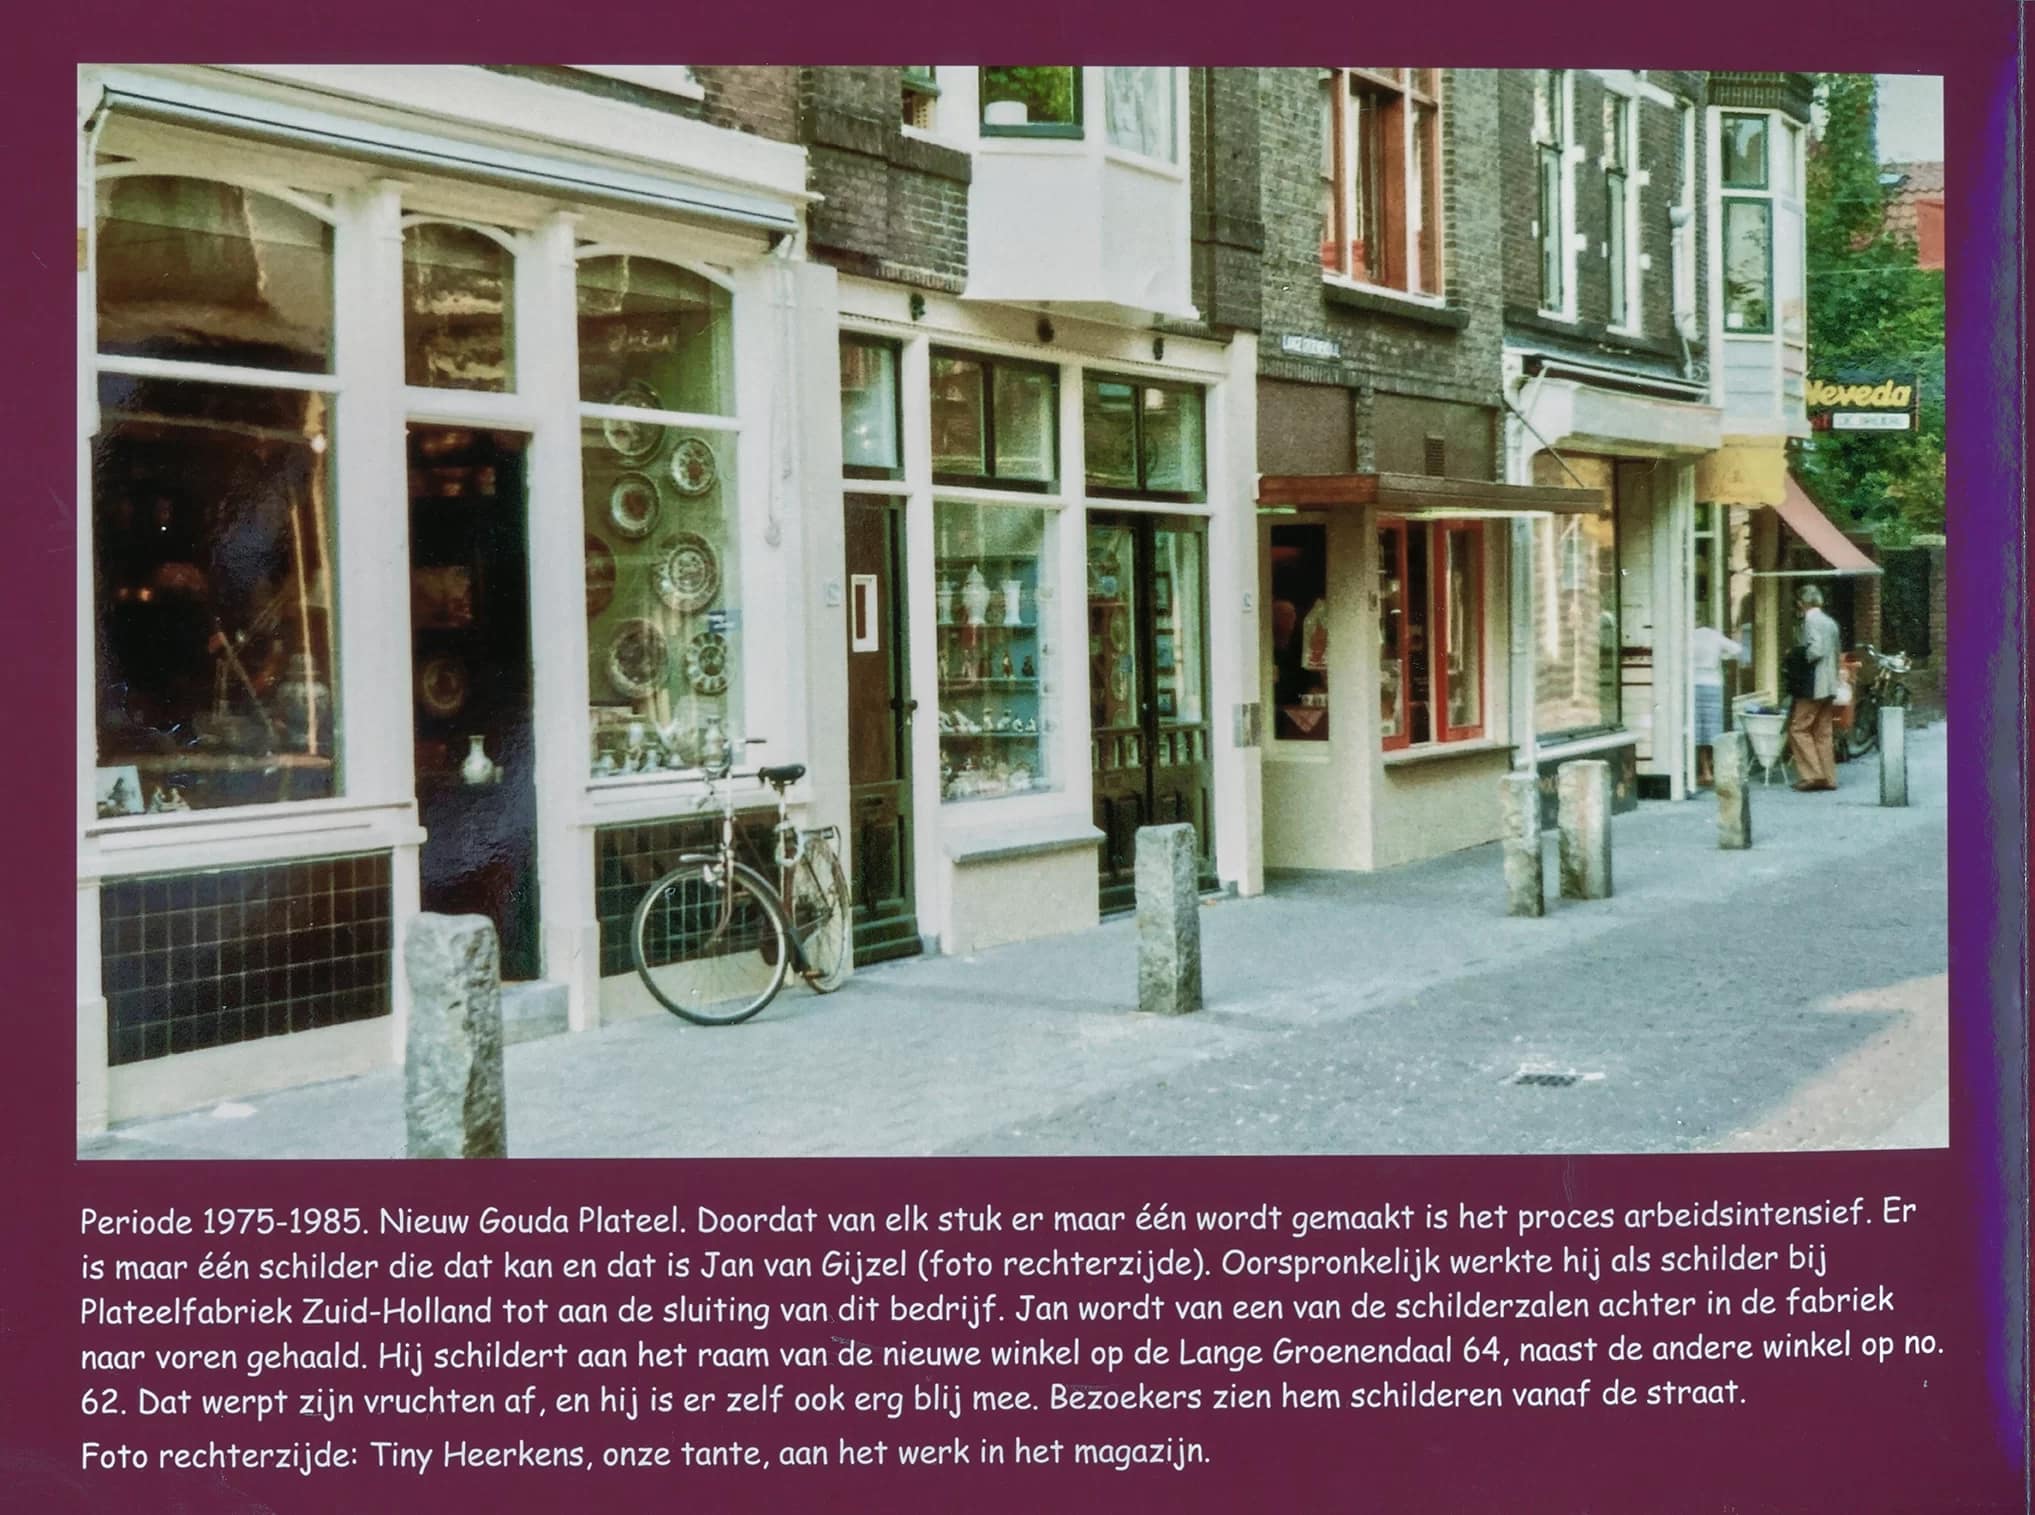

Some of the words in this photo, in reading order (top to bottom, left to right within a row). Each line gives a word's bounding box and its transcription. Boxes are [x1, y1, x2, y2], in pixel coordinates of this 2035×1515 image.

[81, 1207, 193, 1235] Periode
[204, 1207, 369, 1235] 1975-1985.
[380, 1207, 470, 1235] Nieuw
[479, 1205, 569, 1234] Gouda
[579, 1205, 686, 1233] Plateel.
[698, 1204, 818, 1234] Doordat
[827, 1212, 876, 1233] van
[885, 1204, 929, 1232] elk
[937, 1203, 1003, 1232] stuk
[1011, 1212, 1044, 1232] er
[1054, 1211, 1126, 1232] maar
[1135, 1202, 1187, 1231] één
[1196, 1202, 1283, 1231] wordt
[1292, 1202, 1415, 1238] gemaakt
[1426, 1203, 1448, 1230] is
[1459, 1201, 1508, 1229] het
[1518, 1208, 1615, 1237] proces
[1624, 1196, 1872, 1228] arbeidsintensief.
[1883, 1195, 1917, 1224] Er
[82, 1254, 105, 1280] is
[115, 1260, 188, 1281] maar
[198, 1251, 250, 1280] één
[259, 1251, 379, 1280] schilder
[389, 1251, 434, 1279] die
[444, 1251, 493, 1279] dat
[504, 1251, 553, 1279] kan
[563, 1258, 597, 1278] en
[607, 1250, 657, 1278] dat
[667, 1251, 690, 1278] is
[700, 1251, 754, 1279] Jan
[763, 1257, 812, 1277] van
[821, 1249, 906, 1285] Gijzel
[918, 1249, 993, 1282] (foto
[1004, 1247, 1211, 1284] rechterzijde).
[1222, 1246, 1441, 1283] Oorspronkelijk
[1450, 1246, 1553, 1274] werkte
[1563, 1245, 1600, 1281] hij
[1611, 1245, 1651, 1273] als
[1660, 1243, 1779, 1272] schilder
[1789, 1243, 1826, 1277] bij
[81, 1296, 293, 1326] Plateelfabriek
[302, 1295, 492, 1324] Zuid-Holland
[502, 1298, 549, 1324] tot
[558, 1303, 608, 1323] aan
[618, 1295, 654, 1323] de
[663, 1295, 770, 1330] sluiting
[780, 1302, 828, 1322] van
[838, 1294, 880, 1322] dit
[891, 1293, 1004, 1330] bedrijf.
[1015, 1294, 1069, 1322] Jan
[1078, 1292, 1165, 1321] wordt
[1175, 1300, 1223, 1320] van
[1232, 1300, 1283, 1320] een
[1293, 1299, 1341, 1319] van
[1351, 1291, 1387, 1319] de
[1395, 1290, 1589, 1319] schilderzalen
[1598, 1289, 1697, 1317] achter
[1707, 1290, 1731, 1316] in
[1741, 1287, 1777, 1315] de
[1785, 1284, 1894, 1316] fabriek
[81, 1350, 146, 1370] naar
[155, 1349, 237, 1370] voren
[247, 1341, 367, 1377] gehaald.
[379, 1341, 423, 1377] Hij
[433, 1340, 568, 1369] schildert
[577, 1348, 627, 1368] aan
[638, 1340, 688, 1368] het
[698, 1347, 770, 1368] raam
[779, 1347, 828, 1367] van
[838, 1339, 873, 1367] de
[883, 1340, 982, 1367] nieuwe
[991, 1337, 1080, 1366] winkel
[1090, 1345, 1124, 1373] op
[1134, 1337, 1170, 1365] de
[1179, 1338, 1264, 1372] Lange
[1272, 1335, 1452, 1365] Groenendaal
[1463, 1335, 1510, 1367] 64,
[1520, 1337, 1598, 1362] naast
[1608, 1334, 1643, 1361] de
[1652, 1332, 1754, 1361] andere
[1763, 1329, 1851, 1359] winkel
[1861, 1336, 1894, 1364] op
[1904, 1335, 1944, 1355] no.
[81, 1388, 126, 1415] 62.
[139, 1387, 192, 1415] Dat
[202, 1389, 289, 1422] werpt
[299, 1388, 354, 1422] zijn
[363, 1385, 495, 1414] vruchten
[504, 1385, 546, 1417] af,
[556, 1393, 590, 1413] en
[600, 1385, 638, 1421] hij
[651, 1386, 673, 1413] is
[683, 1393, 716, 1412] er
[726, 1383, 784, 1413] zelf
[794, 1383, 845, 1412] ook
[854, 1392, 904, 1419] erg
[914, 1383, 961, 1419] blij
[973, 1390, 1039, 1412] mee.
[1050, 1382, 1202, 1410] Bezoekers
[1212, 1383, 1272, 1409] zien
[1282, 1381, 1341, 1409] hem
[1350, 1380, 1503, 1408] schilderen
[1512, 1378, 1591, 1408] vanaf
[1602, 1378, 1638, 1406] de
[1646, 1379, 1746, 1405] straat.
[82, 1441, 148, 1470] Foto
[159, 1440, 357, 1477] rechterzijde:
[369, 1441, 433, 1476] Tiny
[444, 1439, 593, 1471] Heerkens,
[603, 1446, 671, 1467] onze
[680, 1441, 770, 1470] tante,
[779, 1445, 828, 1466] aan
[839, 1437, 889, 1465] het
[898, 1436, 970, 1465] werk
[981, 1438, 1005, 1464] in
[1015, 1436, 1064, 1464] het
[1074, 1437, 1210, 1471] magazijn.
